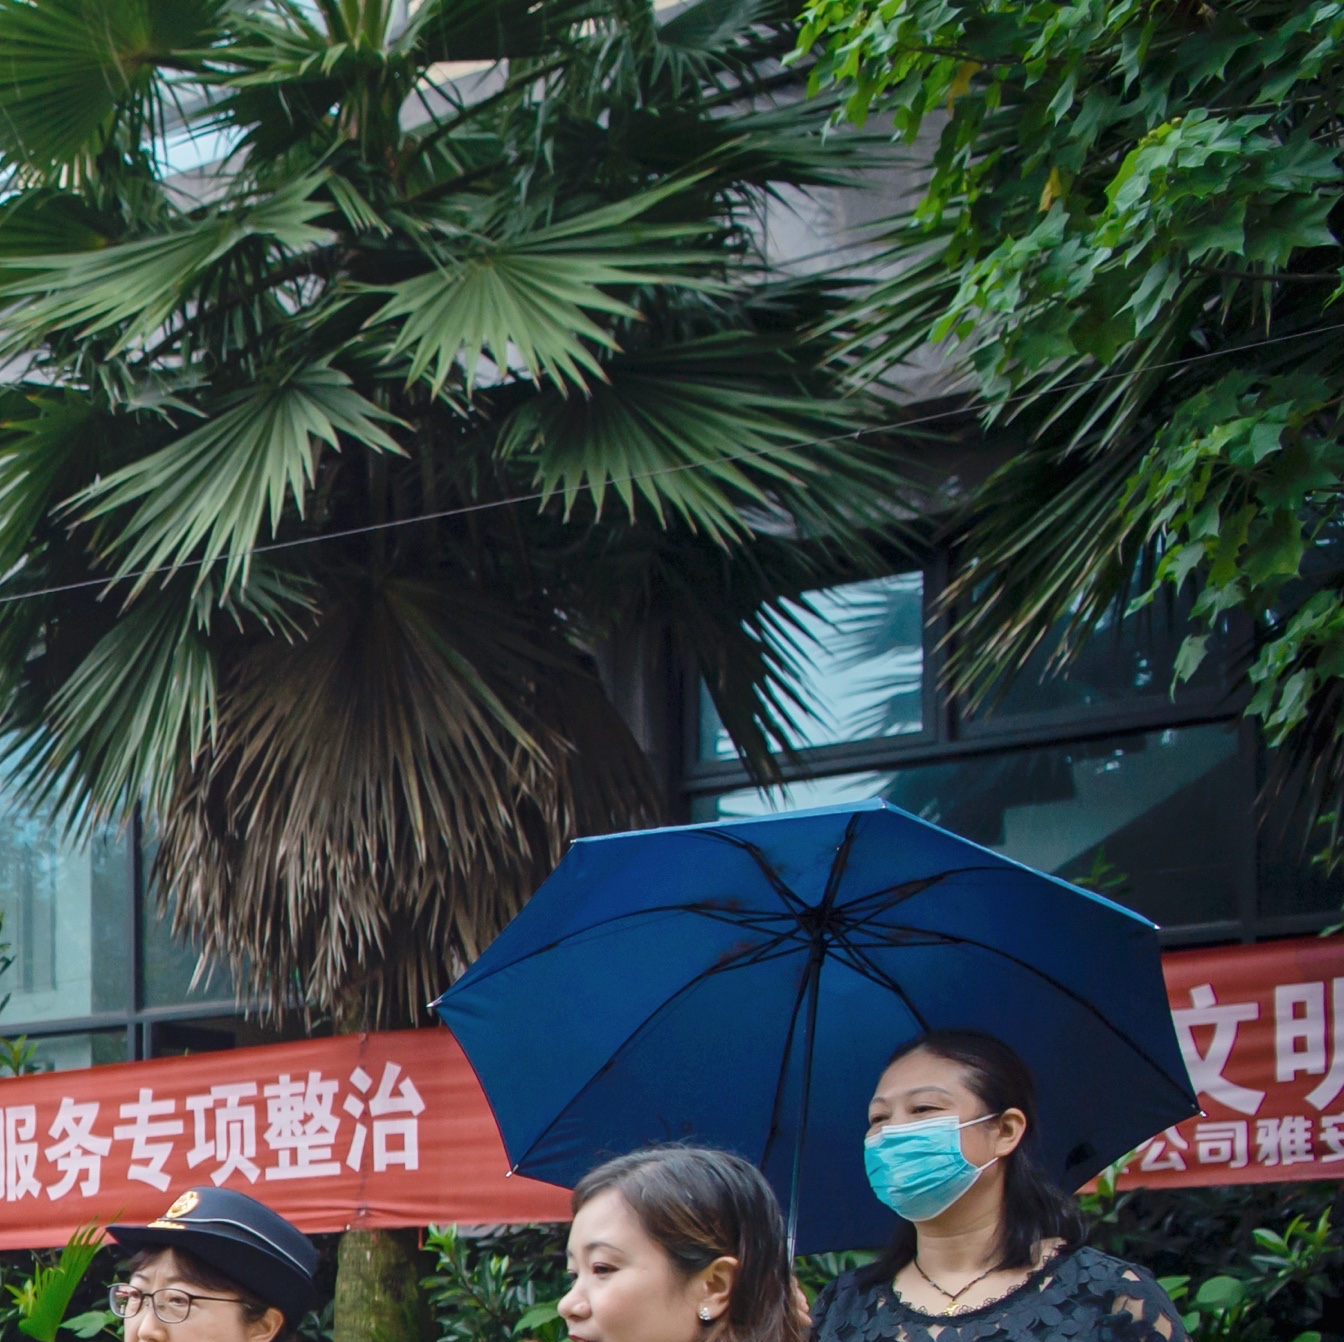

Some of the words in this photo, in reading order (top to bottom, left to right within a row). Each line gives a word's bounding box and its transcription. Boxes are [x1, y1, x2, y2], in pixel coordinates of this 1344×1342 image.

[1170, 976, 1344, 1116] 文明
[1098, 1113, 1344, 1176] 公司雅
